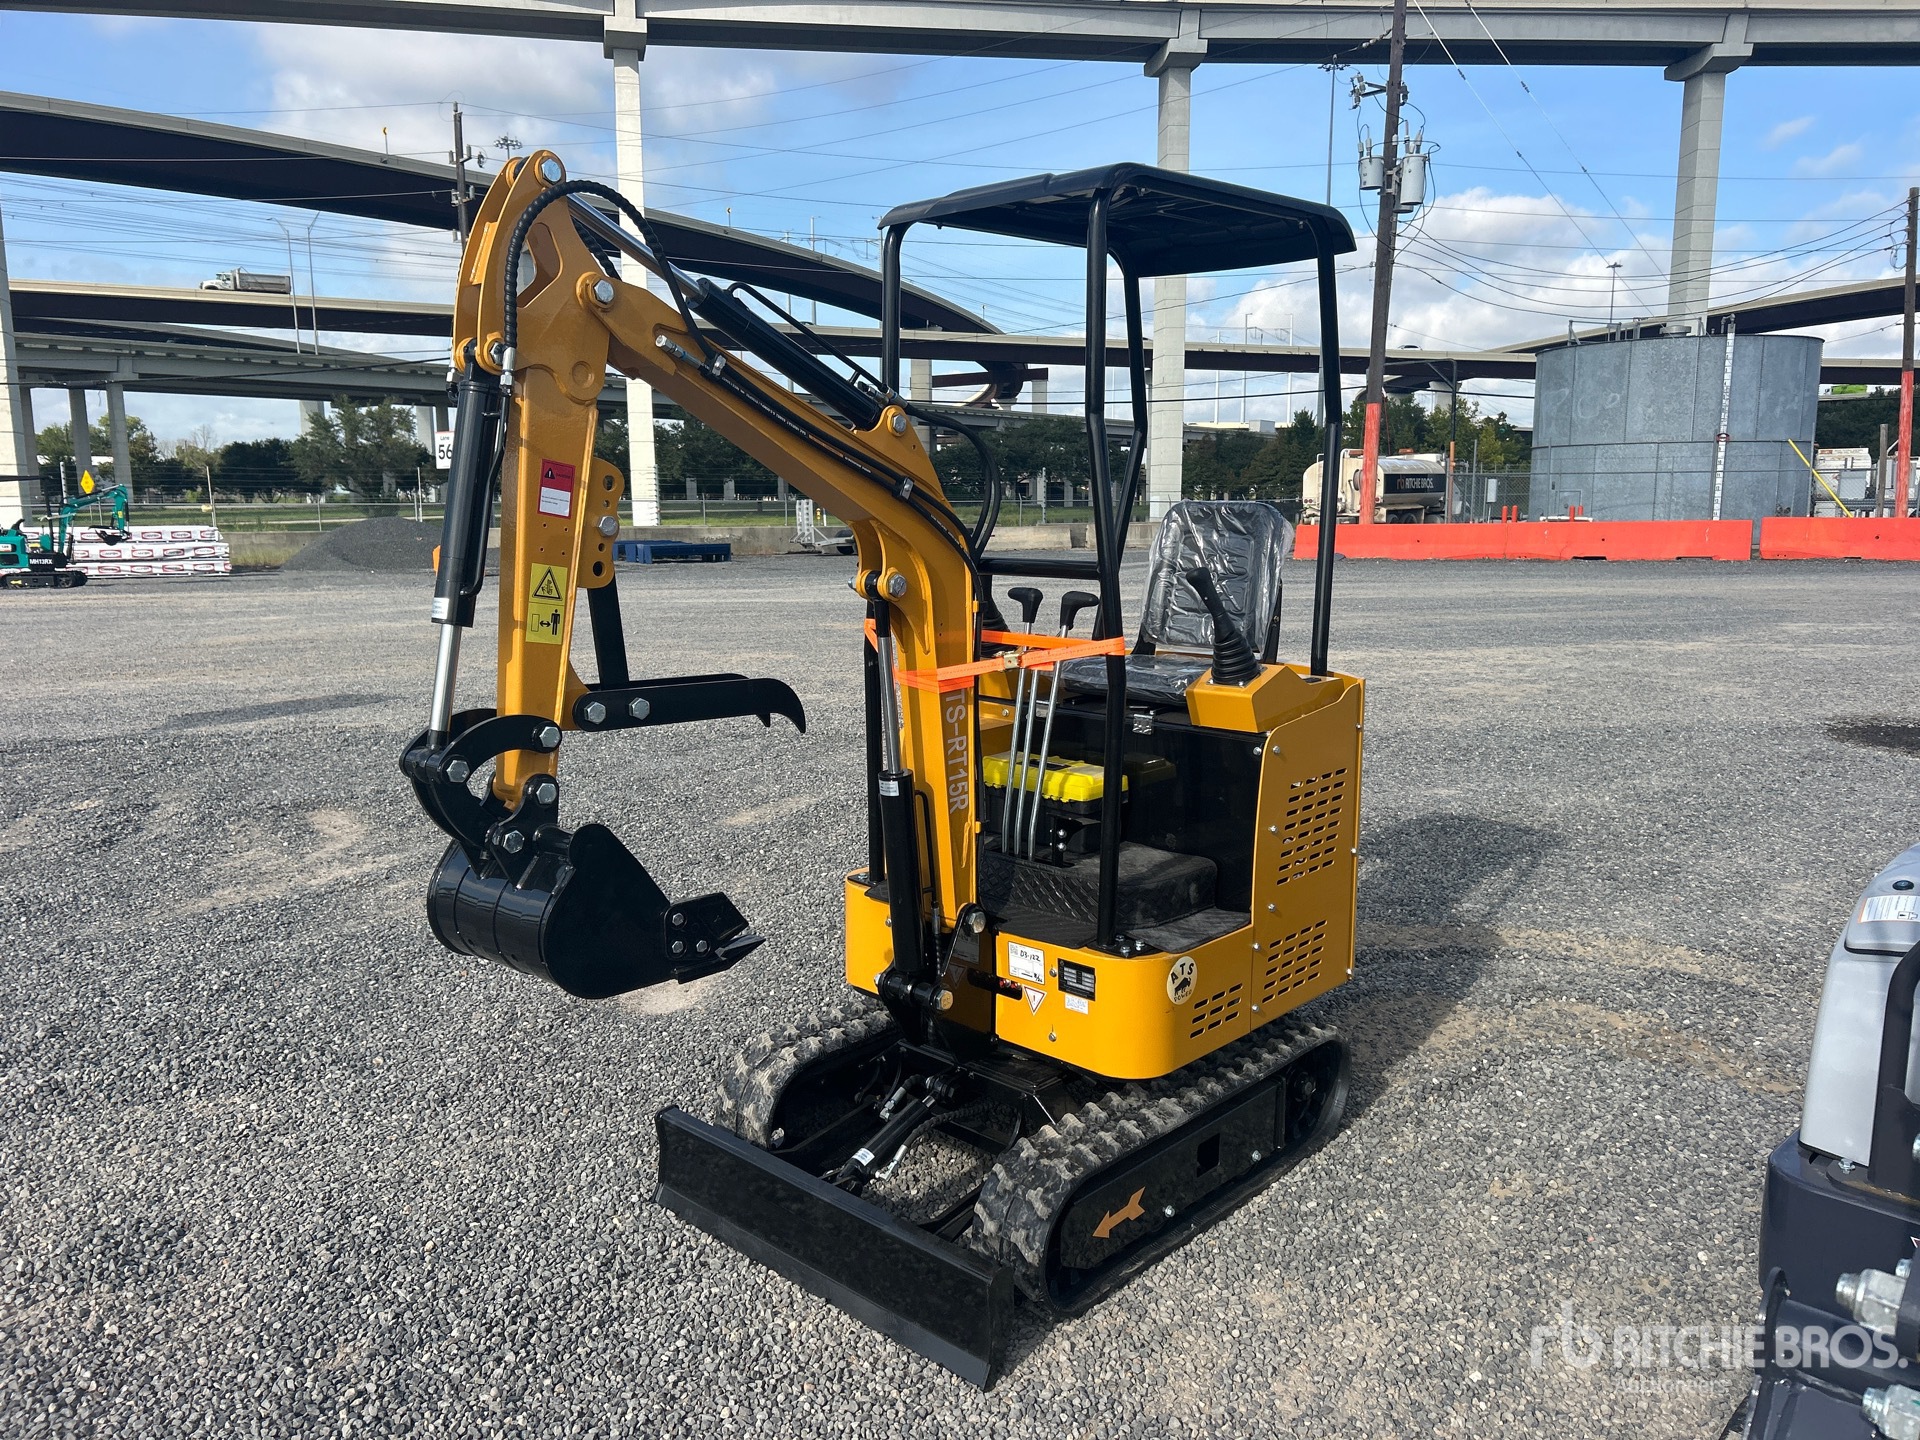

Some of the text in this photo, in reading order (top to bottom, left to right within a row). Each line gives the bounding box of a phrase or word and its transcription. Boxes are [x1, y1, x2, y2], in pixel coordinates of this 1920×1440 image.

[438, 444, 452, 460] 56
[1405, 477, 1421, 489] RITCHIE
[1173, 989, 1193, 1002] POWER
